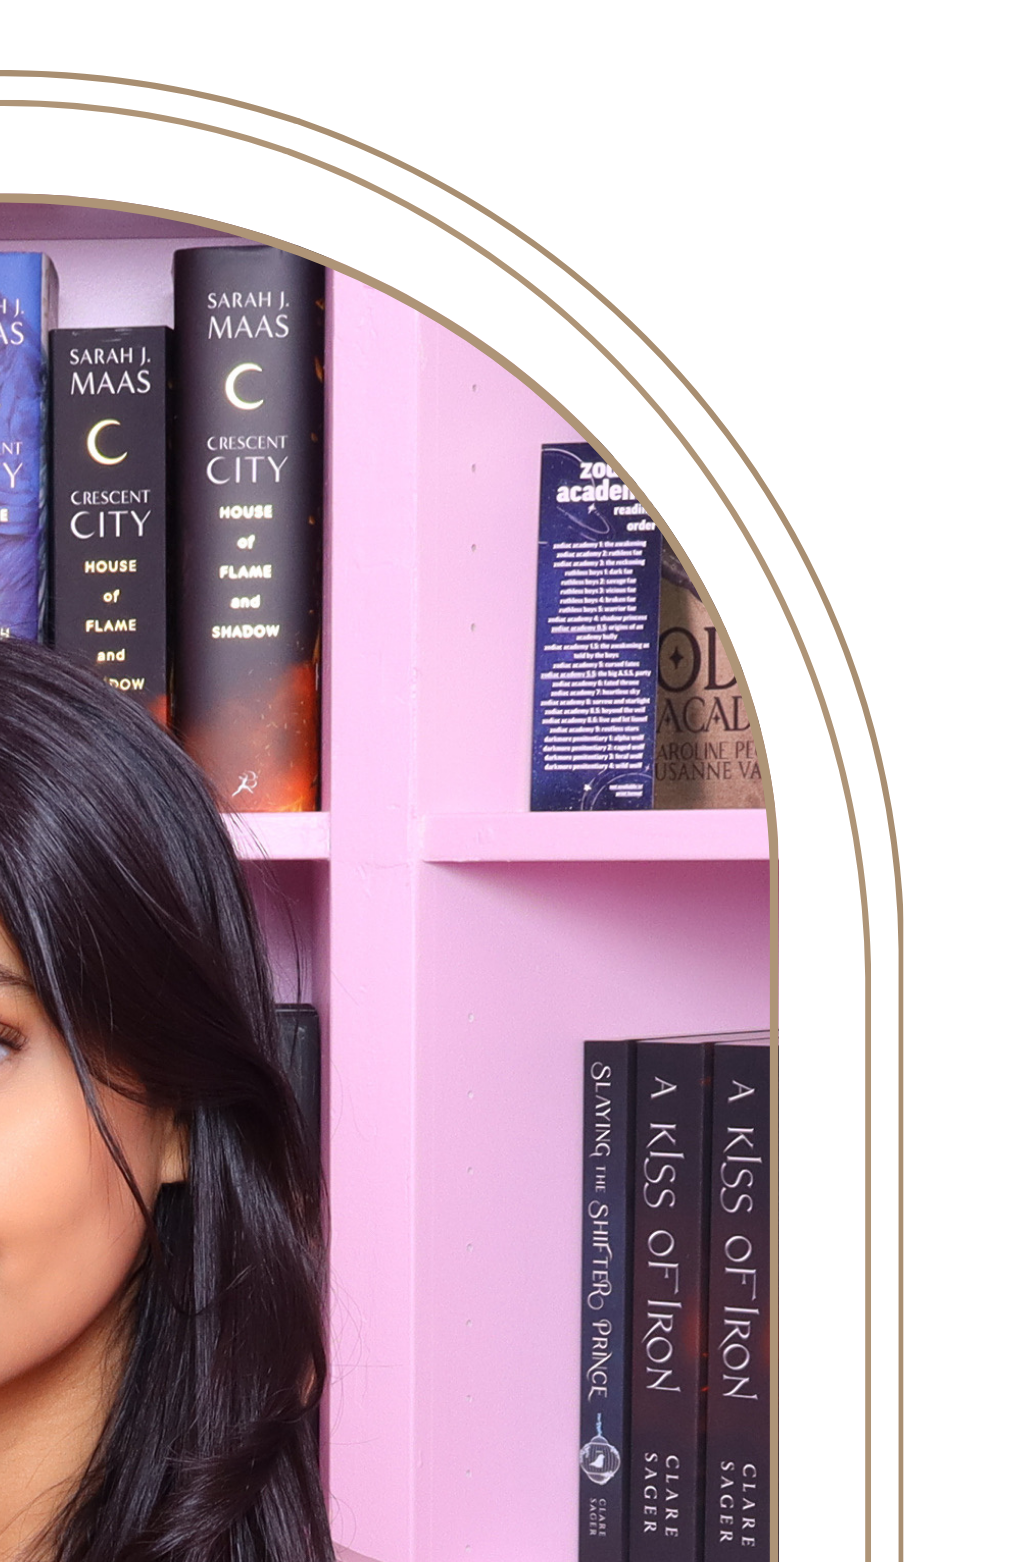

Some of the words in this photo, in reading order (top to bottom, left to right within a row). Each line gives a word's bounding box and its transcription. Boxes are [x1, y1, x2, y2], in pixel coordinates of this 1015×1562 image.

[15, 299, 24, 316] J.
[208, 292, 271, 308] SARAH
[280, 291, 289, 309] J.
[209, 315, 288, 338] MAAS
[70, 348, 132, 364] SARAH
[141, 347, 150, 365] J.
[71, 370, 150, 394] MAAS
[208, 436, 285, 450] CRESCENT
[207, 456, 287, 484] CITY
[71, 490, 148, 505] CRESCENT
[220, 505, 272, 519] HOUSE
[71, 511, 150, 539] CITY
[626, 519, 656, 531] order
[237, 535, 255, 549] of
[85, 560, 136, 573] HOUSE
[220, 565, 271, 579] FLAME
[104, 590, 119, 602] of
[231, 595, 260, 608] and
[86, 619, 136, 632] FLAME
[212, 624, 279, 638] SHADOW
[98, 649, 125, 661] and
[109, 678, 145, 690] DOW
[656, 742, 728, 760] AROLINE
[735, 741, 758, 760] PE
[655, 761, 732, 780] USANNE
[650, 1076, 677, 1099] A
[728, 1080, 755, 1102] A
[588, 1061, 612, 1159] SLAYING
[643, 1122, 684, 1209] KISS
[720, 1127, 762, 1213] KISS
[595, 1166, 606, 1193] THE
[587, 1200, 613, 1310] SHIFTER
[647, 1230, 679, 1294] OF
[724, 1235, 757, 1301] OF
[641, 1300, 682, 1393] IRON
[718, 1305, 759, 1400] IRON
[587, 1319, 613, 1402] PRINCE
[644, 1453, 658, 1533] SAGER
[665, 1455, 679, 1537] CLARE
[719, 1460, 734, 1543] SAGER
[589, 1497, 597, 1535] SAGER
[599, 1498, 607, 1536] CLARE
[741, 1463, 756, 1548] CLARE
